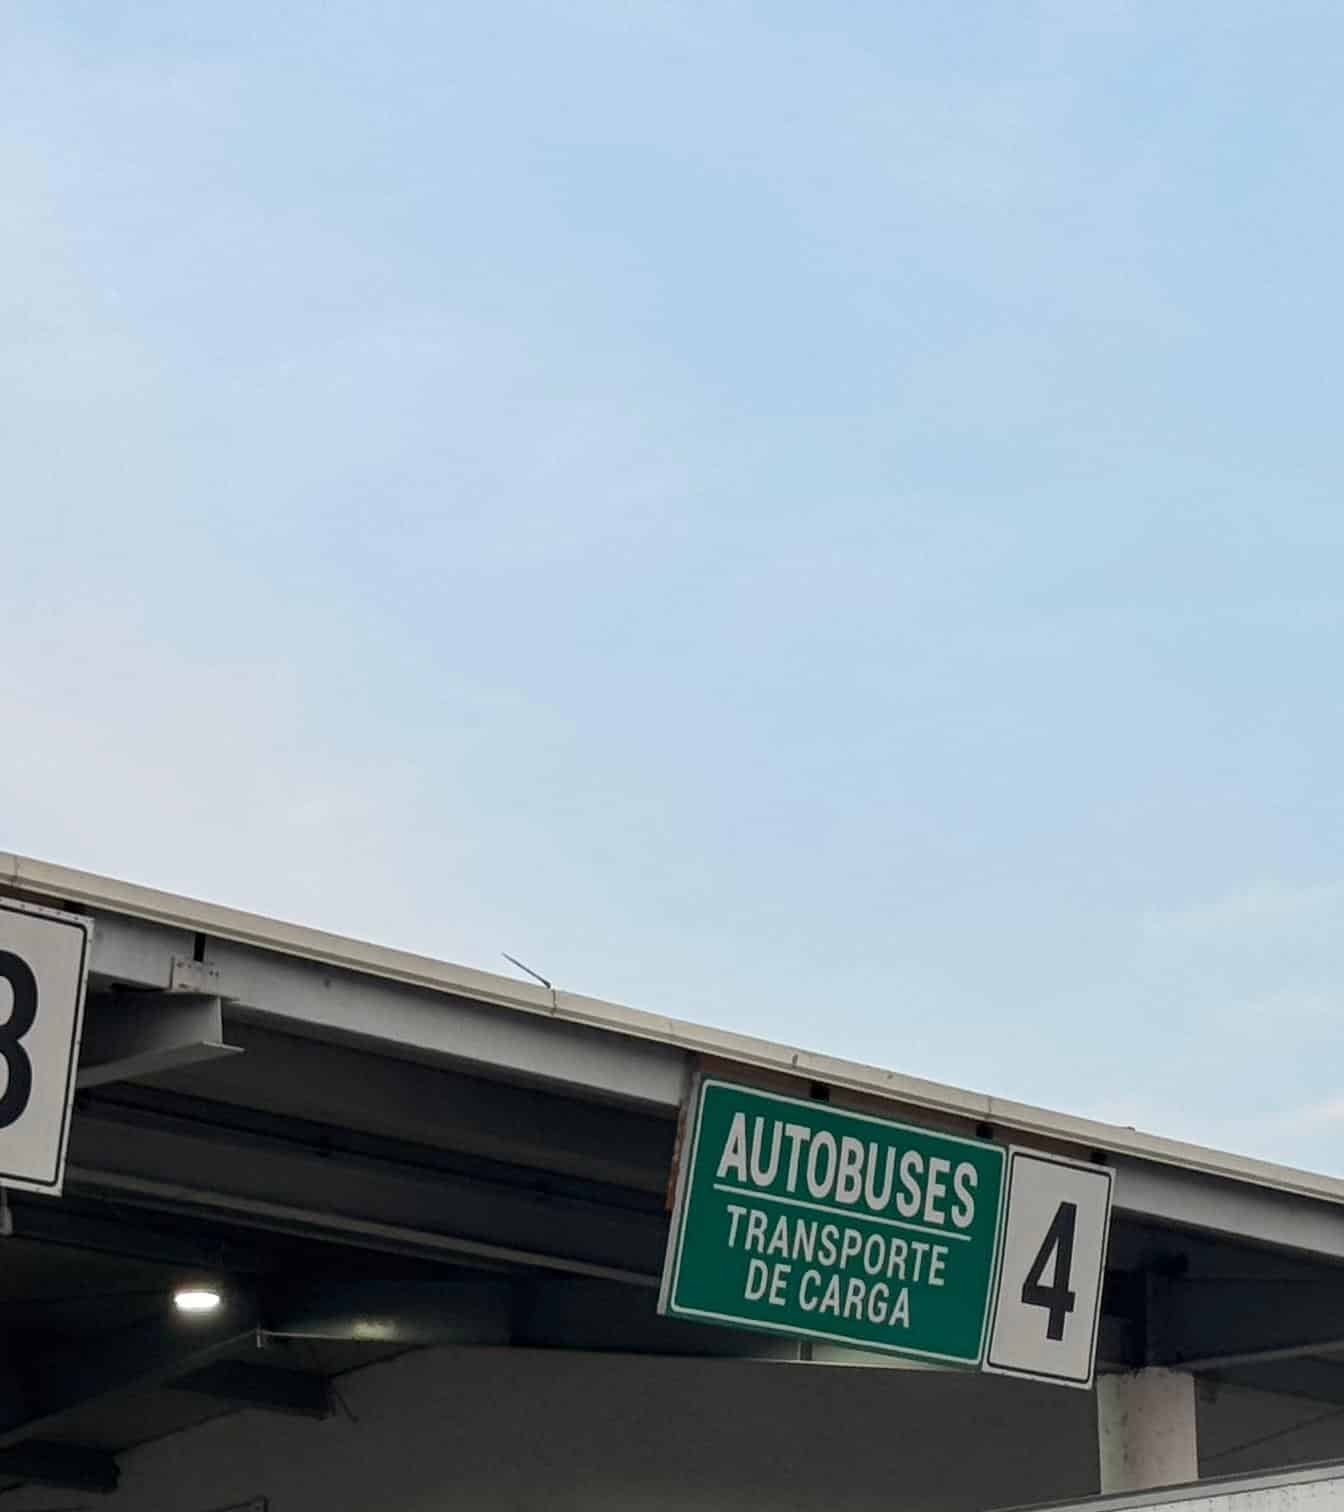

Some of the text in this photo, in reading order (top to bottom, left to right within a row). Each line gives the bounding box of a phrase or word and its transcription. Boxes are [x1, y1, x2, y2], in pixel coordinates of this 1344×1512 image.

[716, 1113, 978, 1228] AUTOBUSES
[727, 1205, 949, 1286] TRANSPORTE
[744, 1259, 910, 1328] DE CARGA
[1022, 1202, 1078, 1341] 4
